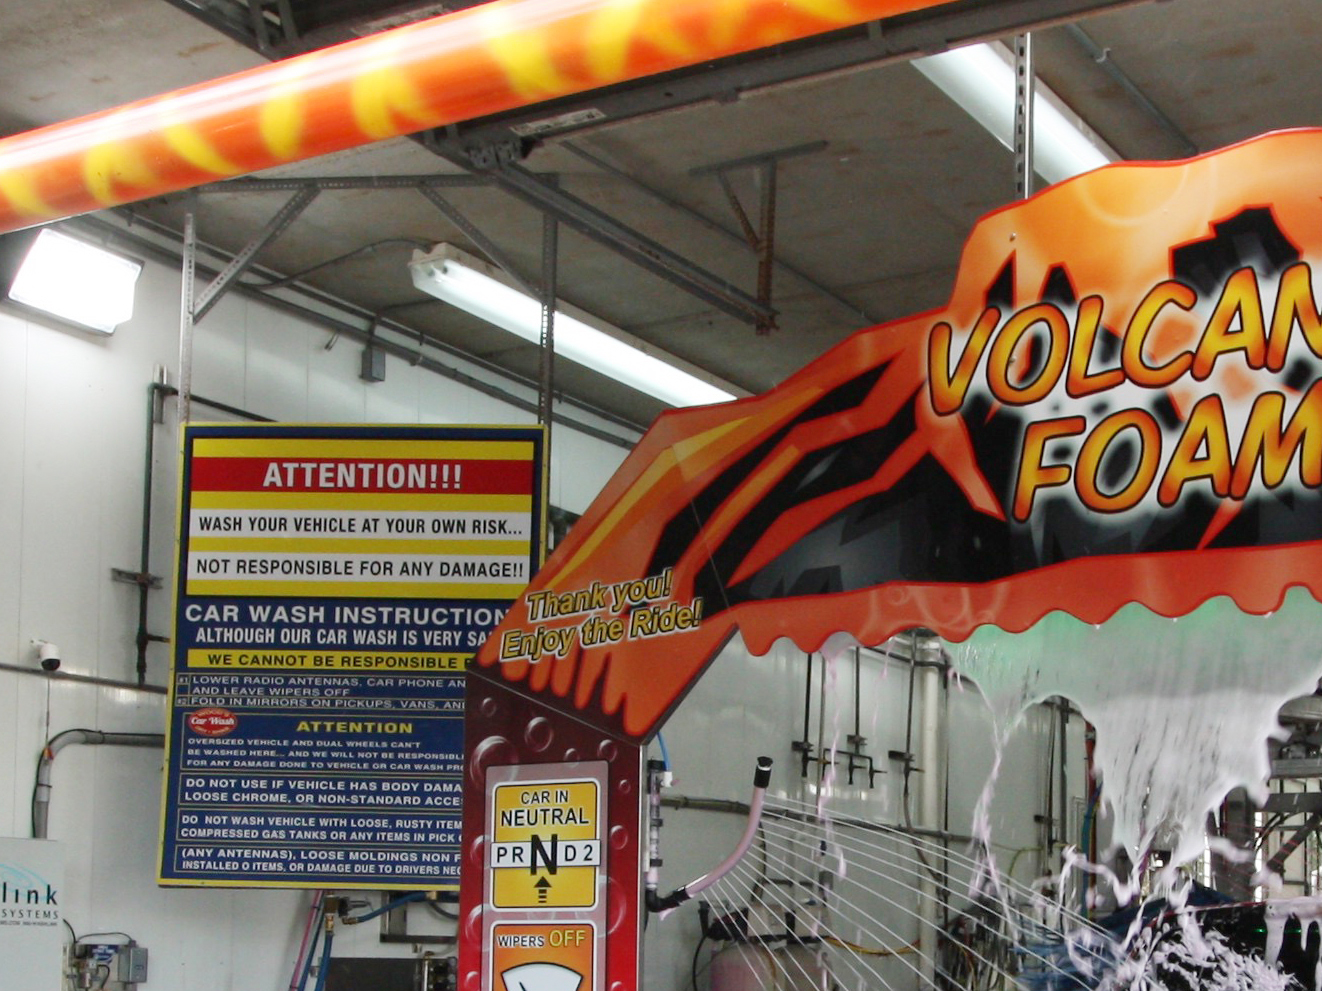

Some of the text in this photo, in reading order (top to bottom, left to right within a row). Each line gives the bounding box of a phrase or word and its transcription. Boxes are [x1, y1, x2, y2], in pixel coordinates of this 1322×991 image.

[263, 462, 462, 489] ATTENTION!!!
[199, 516, 523, 535] WASH YOUR VEHICLE AT YOUR OWN RISK...
[196, 558, 524, 578] NOT RESPONSIBLE FOR ANY DAMAGE!!
[527, 568, 675, 622] Thank you!
[185, 604, 239, 622] CAR
[249, 605, 325, 623] WASH
[196, 627, 462, 646] ALTHOUGH OUR CAR WASH IS VERY
[502, 600, 703, 662] Enjoy the Ride!
[208, 653, 233, 665] WE
[238, 654, 307, 666] CANNOT
[313, 655, 337, 667] BE
[340, 655, 458, 669] RESPONSIBLE
[192, 675, 239, 685] LOWER
[243, 676, 285, 685] RADIO
[366, 678, 394, 687] CAR
[398, 679, 444, 688] PHONE
[192, 686, 351, 697] AND LEAVE WIPERS OFF
[191, 697, 225, 706] FOLD
[229, 697, 243, 706] IN
[246, 698, 307, 707] MIRRORS
[311, 699, 331, 707] ON
[191, 716, 235, 725] Car Wash
[295, 720, 414, 734] ATTENTION
[187, 738, 245, 746] OVERSIZED
[246, 739, 289, 747] VEHICLE
[291, 739, 314, 747] AND
[345, 740, 388, 748] WHEELS
[233, 760, 277, 768] DAMAGE
[327, 762, 370, 770] VEHICLE
[185, 778, 205, 788] DO
[209, 778, 238, 788] NOT
[241, 779, 268, 789] USE
[271, 780, 284, 789] IF
[287, 780, 345, 790] VEHICLE
[349, 781, 378, 791] HAS
[381, 782, 420, 792] BODY
[184, 791, 229, 801] LOOSE
[295, 793, 314, 803] OR
[317, 794, 422, 805] NON-STANDARD
[520, 790, 569, 804] CAR IN
[181, 815, 198, 824] DO
[204, 815, 229, 825] NOT
[230, 816, 265, 826] WASH
[267, 816, 316, 827] VEHICLE
[319, 817, 347, 827] WITH
[395, 819, 433, 829] RUSTY
[500, 808, 590, 827] NEUTRAL
[180, 828, 259, 839] COMPRESSED
[288, 830, 327, 840] TANKS
[330, 830, 347, 840] OR
[349, 831, 373, 841] ANY
[376, 832, 411, 842] ITEMS
[413, 832, 425, 842] IN
[428, 833, 456, 843] PICK
[181, 848, 214, 858] (ANY
[300, 850, 345, 860] LOOSE
[348, 851, 418, 862] MOLDINGS
[421, 852, 450, 862] NON
[182, 860, 239, 870] INSTALLED
[288, 862, 305, 872] OR
[306, 863, 351, 873] DAMAGE
[354, 864, 376, 874] DUE
[378, 864, 393, 874] TO
[395, 865, 440, 875] DRIVERS
[497, 929, 586, 947] WIPERS OFF
